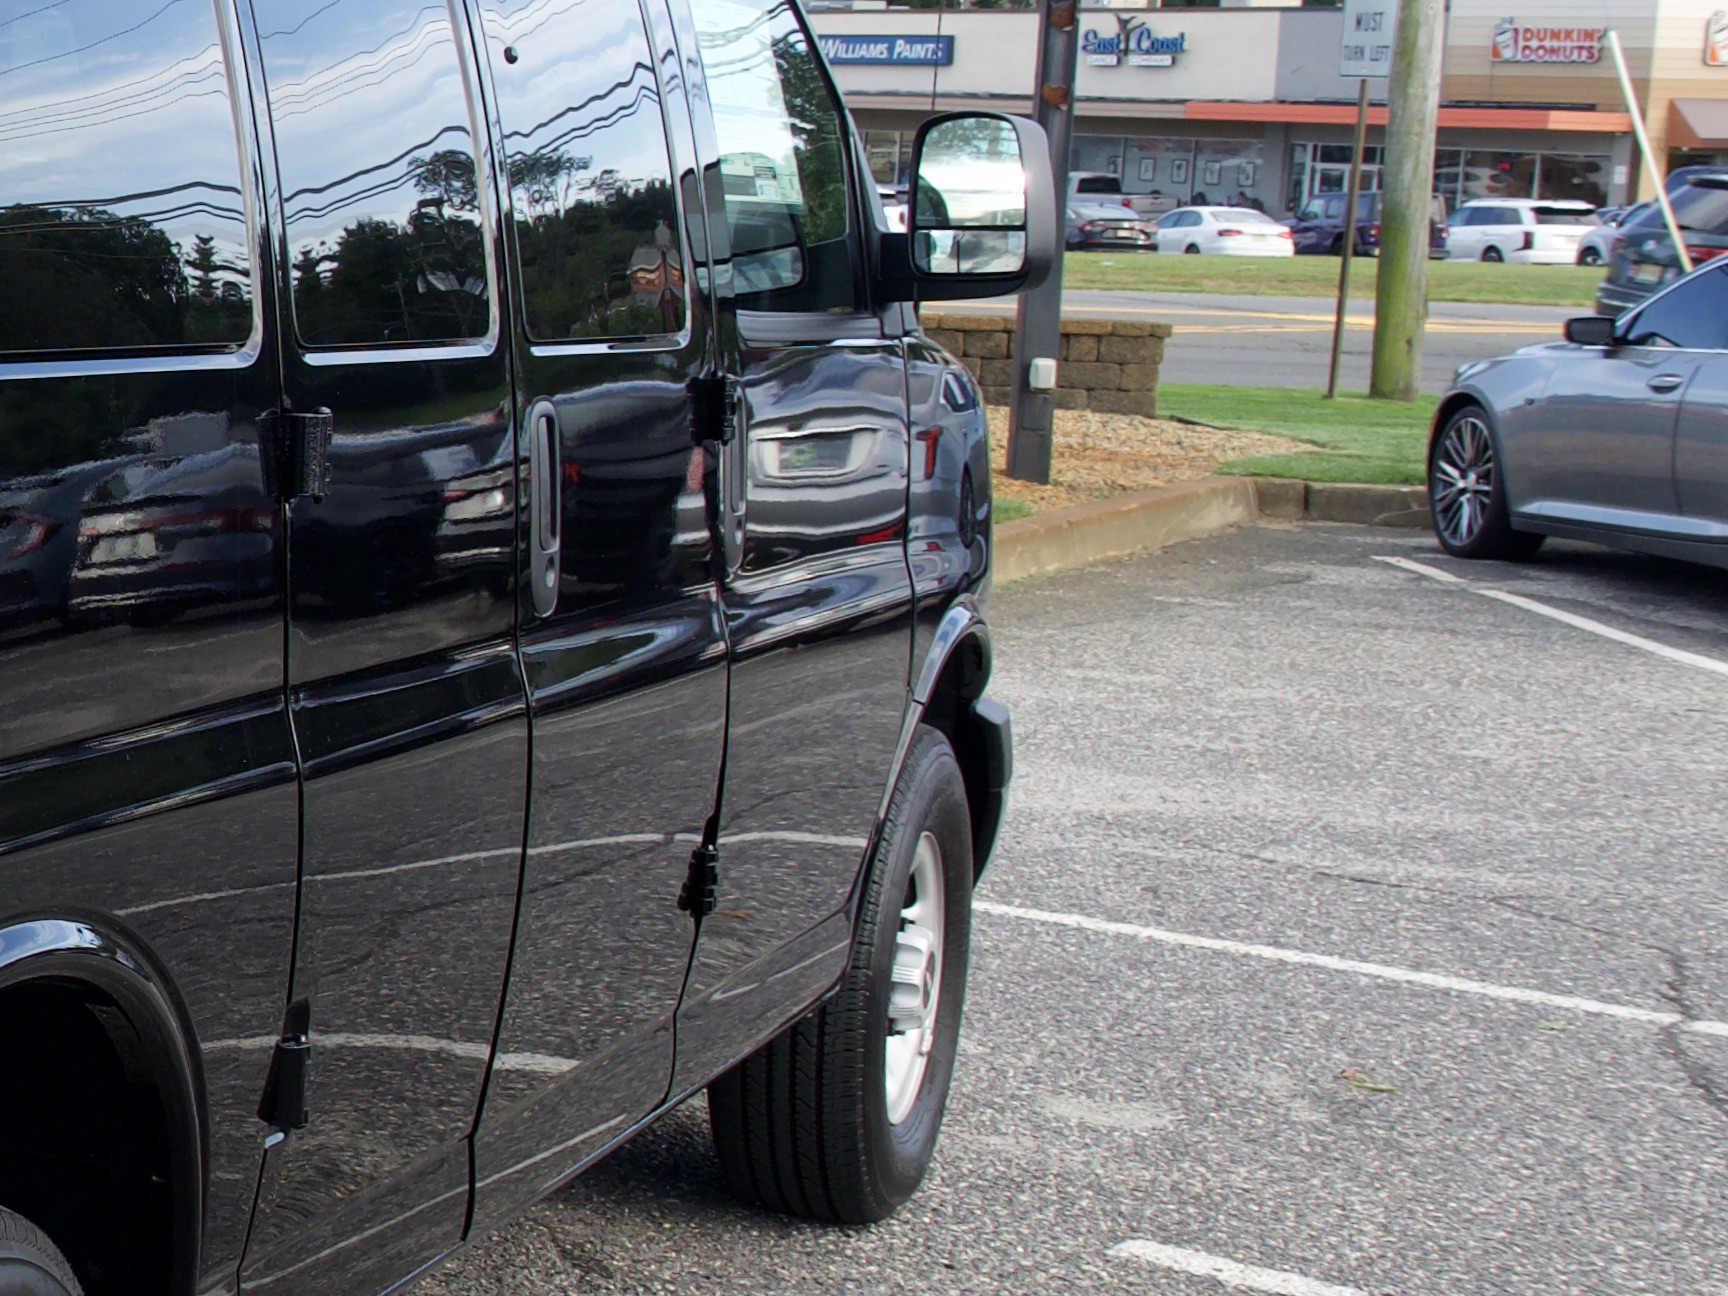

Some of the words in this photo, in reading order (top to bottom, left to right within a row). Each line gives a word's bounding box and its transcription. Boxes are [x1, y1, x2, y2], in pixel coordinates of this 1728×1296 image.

[1355, 11, 1384, 32] MUST
[1081, 28, 1122, 54] East
[1135, 26, 1185, 54] Coast
[1522, 27, 1602, 42] DUNKIN'
[821, 39, 888, 58] WILLIAMS
[892, 39, 942, 59] PAINTS
[1369, 45, 1390, 62] LEFT
[1521, 44, 1596, 60] DONUTS
